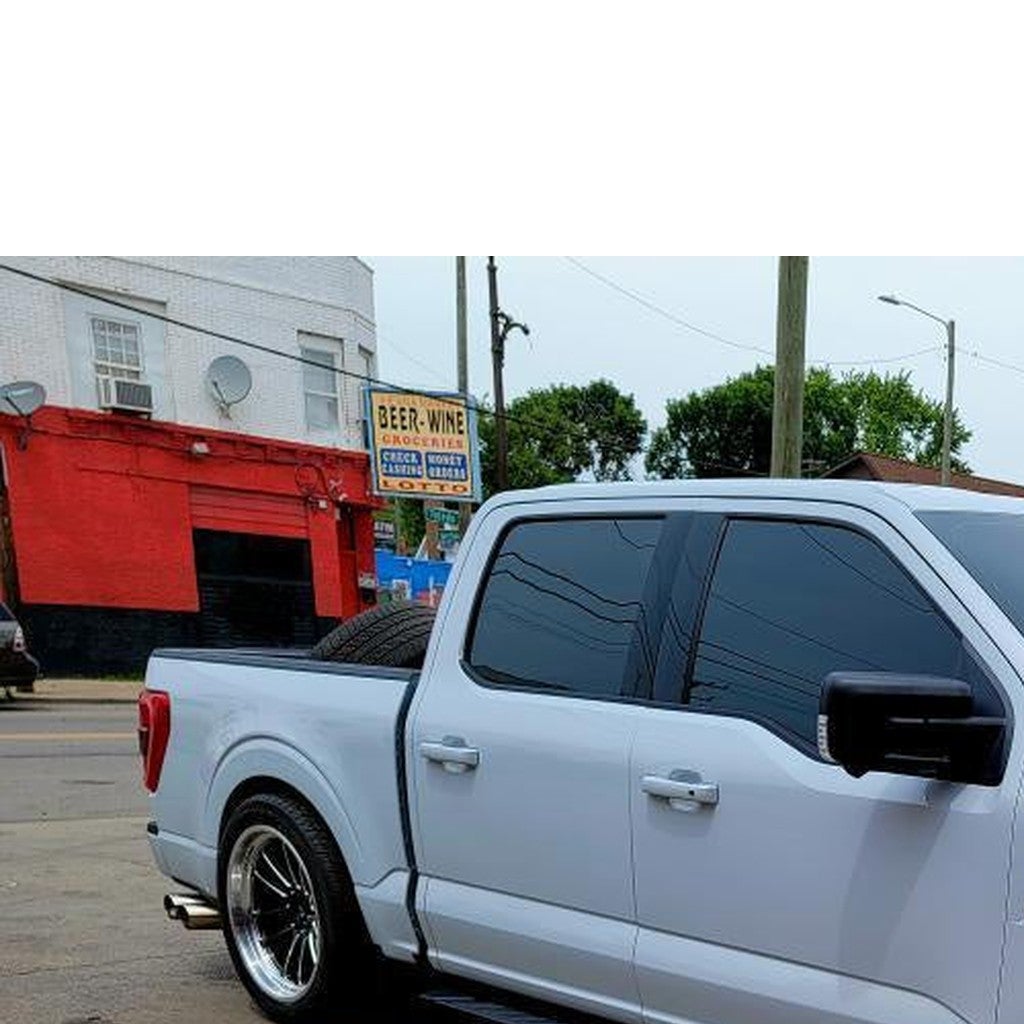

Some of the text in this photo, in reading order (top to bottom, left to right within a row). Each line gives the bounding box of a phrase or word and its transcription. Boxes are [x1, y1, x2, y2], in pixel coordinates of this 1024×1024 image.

[382, 434, 464, 449] GROCERIES
[382, 450, 419, 463] CHECK
[427, 454, 464, 466] MONEY
[381, 480, 468, 492] LOTTO
